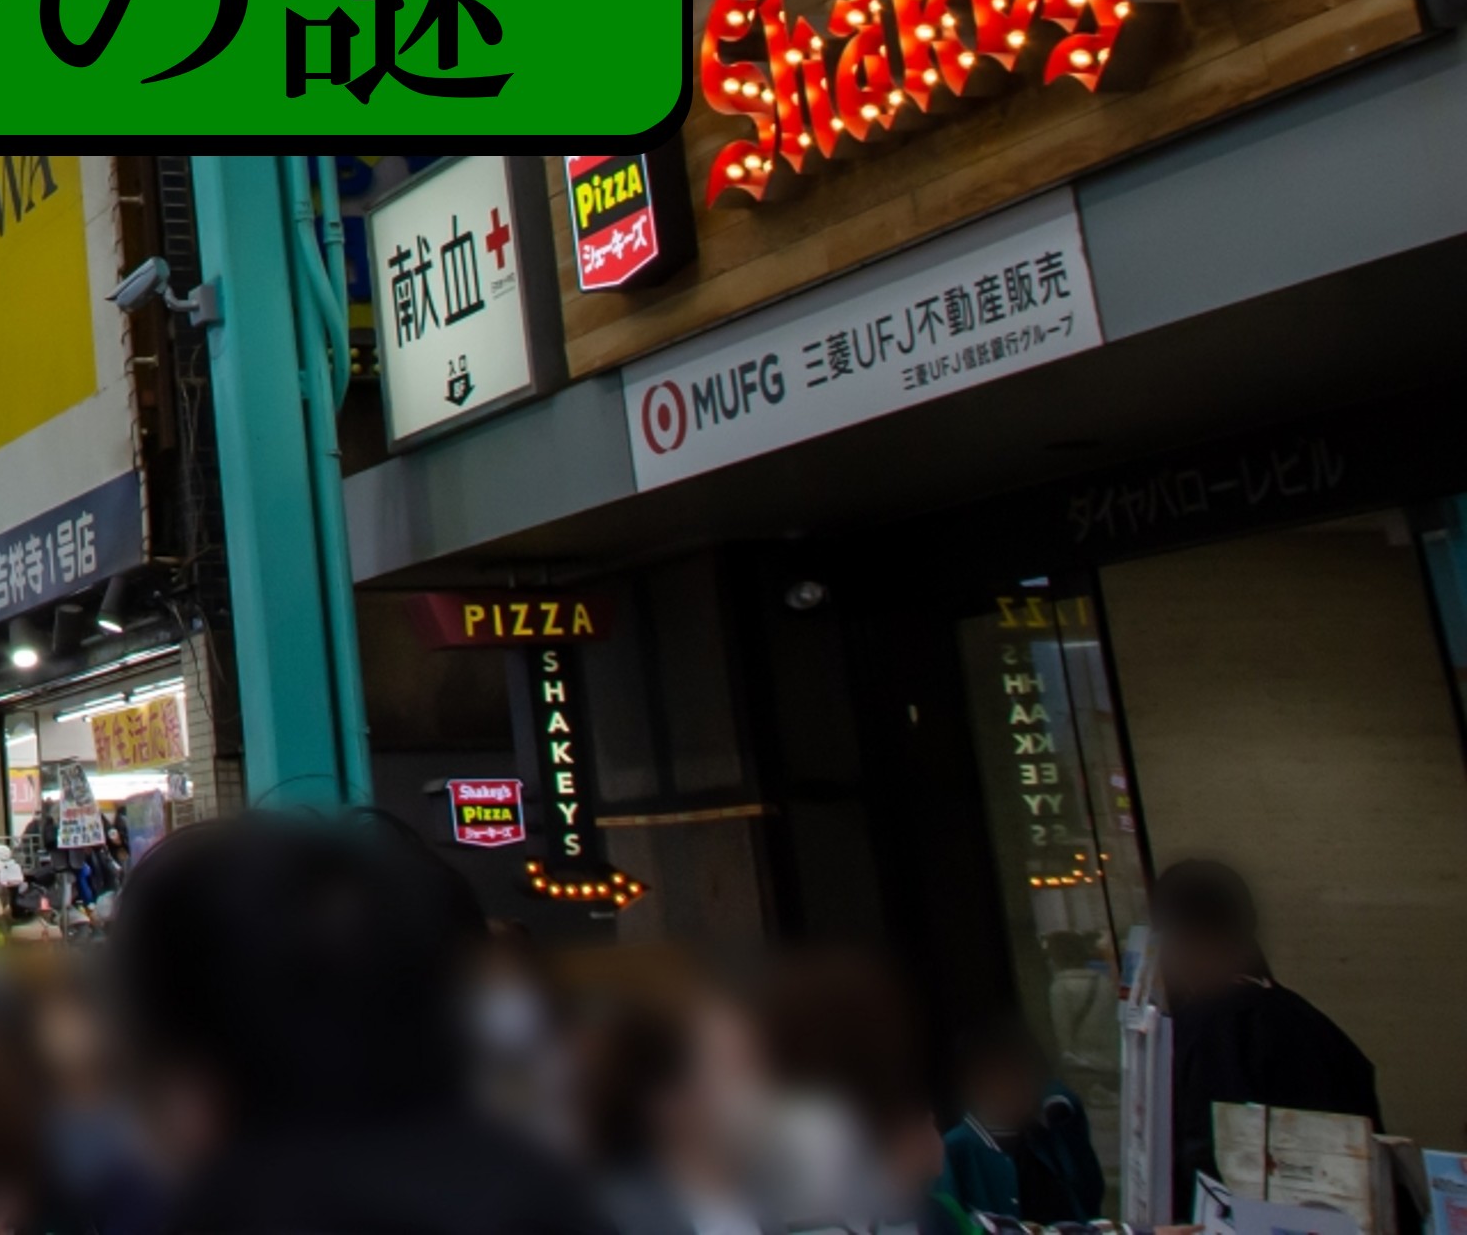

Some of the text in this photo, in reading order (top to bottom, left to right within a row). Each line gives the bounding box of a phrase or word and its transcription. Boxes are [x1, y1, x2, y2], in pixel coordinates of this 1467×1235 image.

[387, 215, 486, 348] 献血
[692, 251, 1071, 429] MUFG 三菱UFJ不動産販売
[464, 603, 595, 637] PIZZA
[540, 650, 582, 857] SHAKEYS
